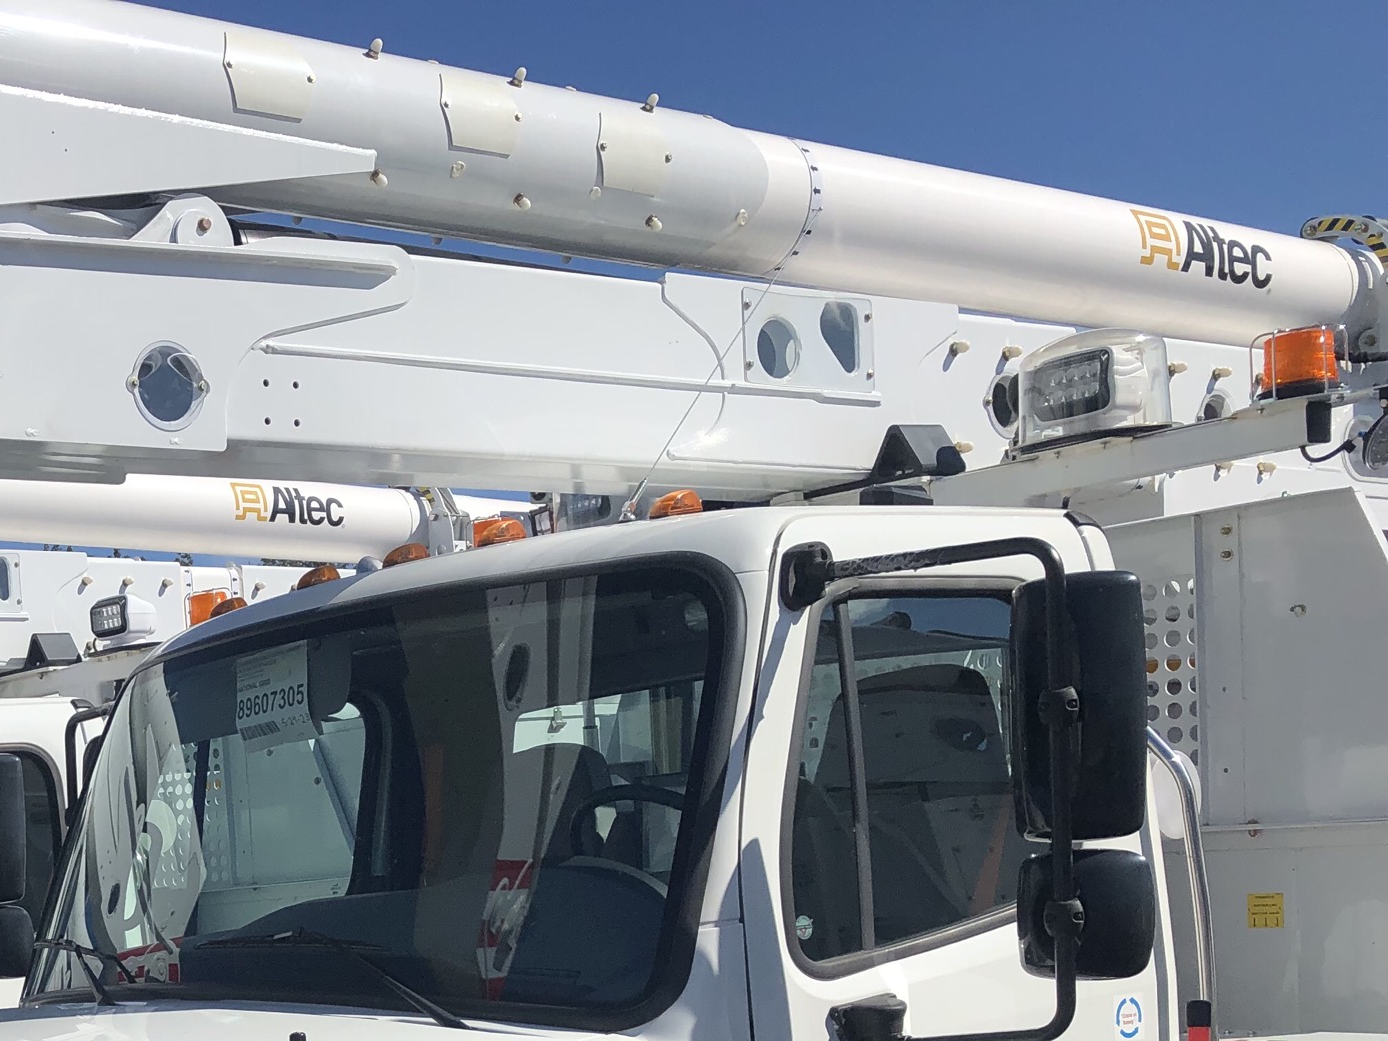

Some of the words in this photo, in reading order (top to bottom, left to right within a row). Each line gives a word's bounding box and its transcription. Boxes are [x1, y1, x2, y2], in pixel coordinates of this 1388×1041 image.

[1180, 219, 1273, 290] Altec
[268, 485, 345, 527] Altec
[237, 683, 305, 720] 89607305
